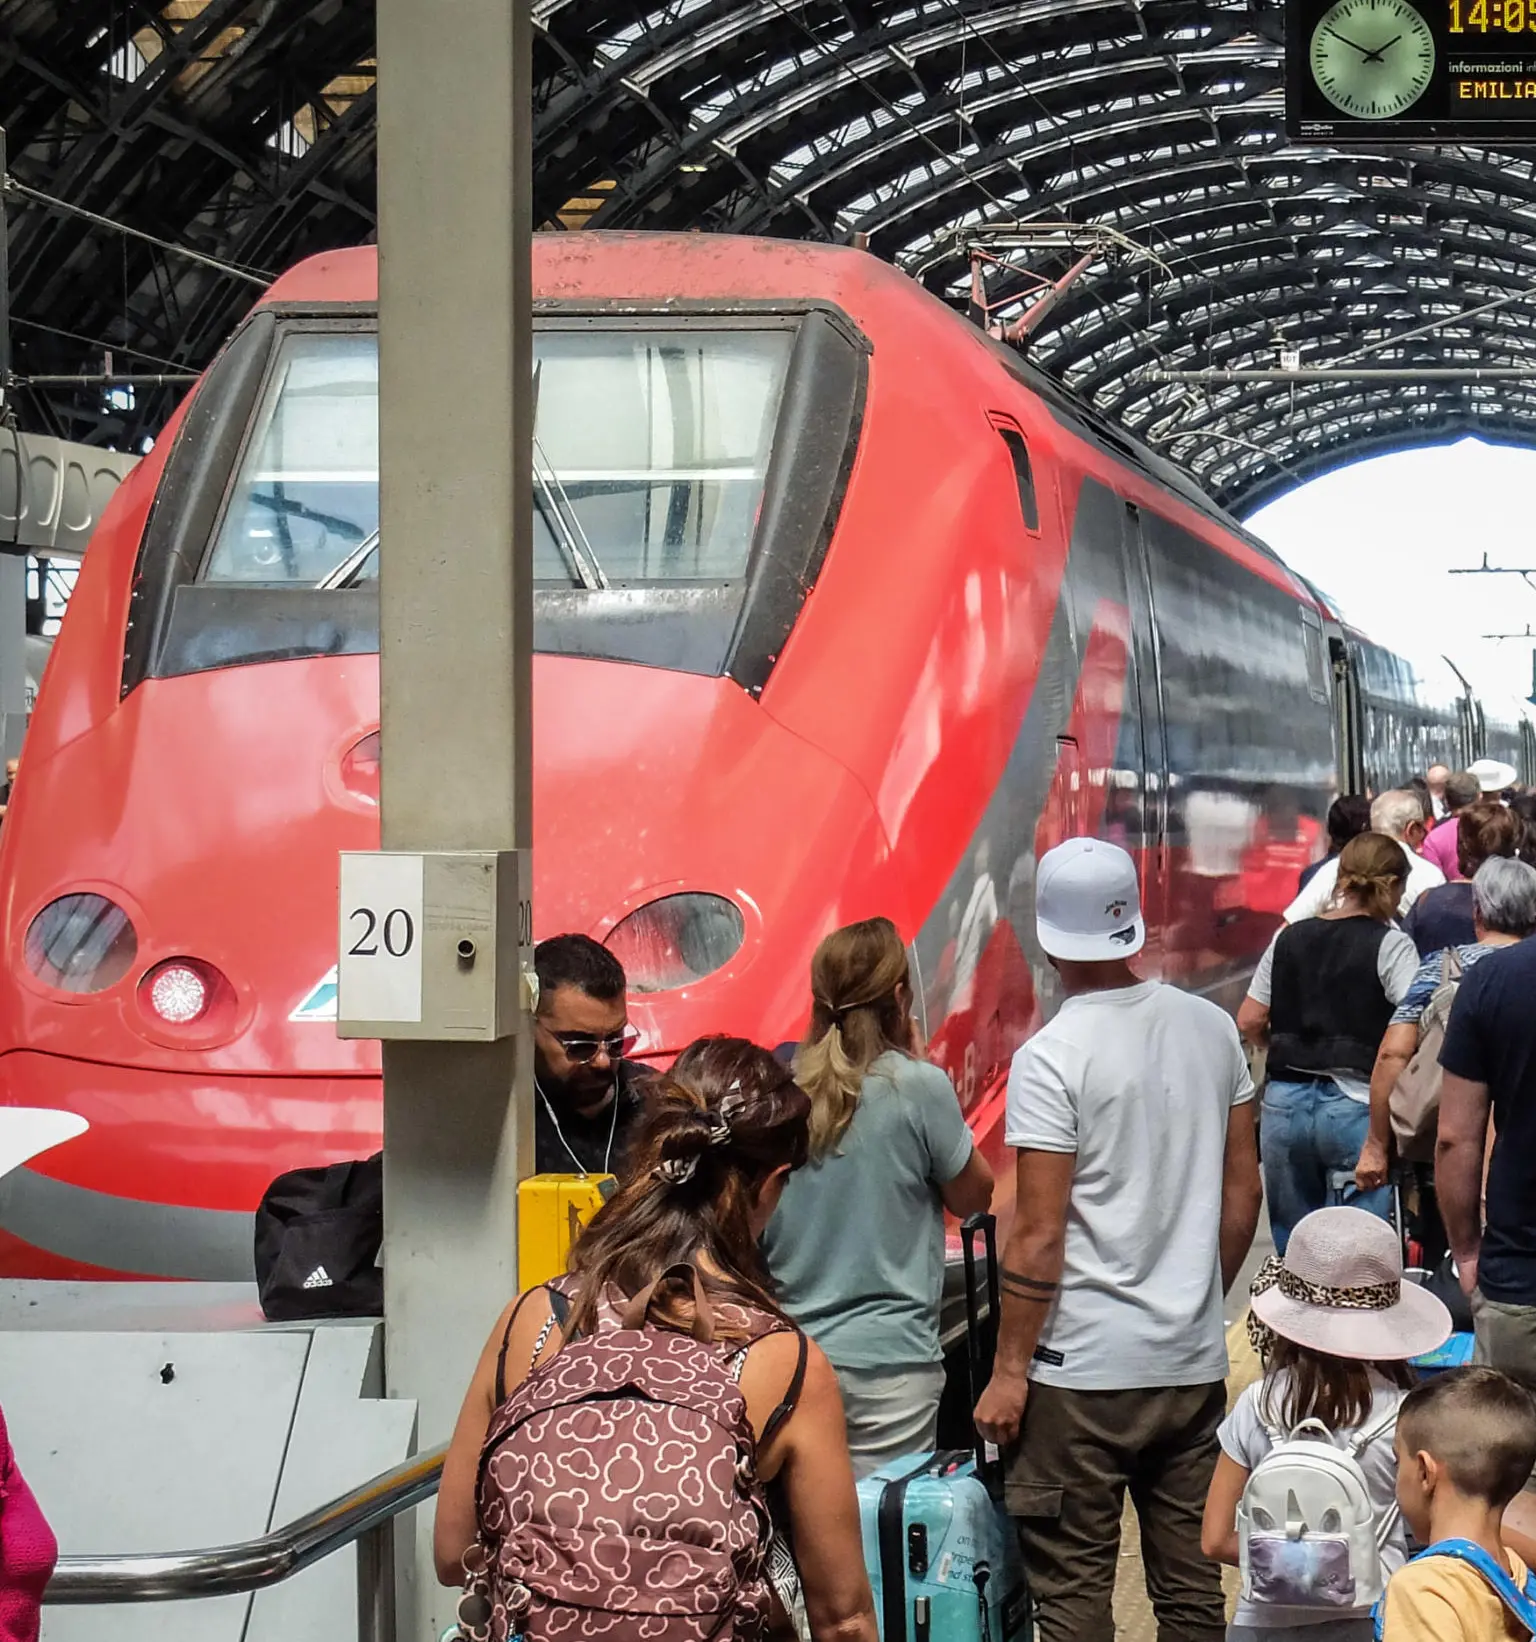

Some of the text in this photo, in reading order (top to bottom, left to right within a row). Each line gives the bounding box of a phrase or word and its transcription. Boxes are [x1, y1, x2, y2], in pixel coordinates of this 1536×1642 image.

[1449, 62, 1523, 73] informazioni
[348, 908, 414, 957] 20
[518, 900, 532, 947] 20
[303, 1279, 333, 1289] adidas
